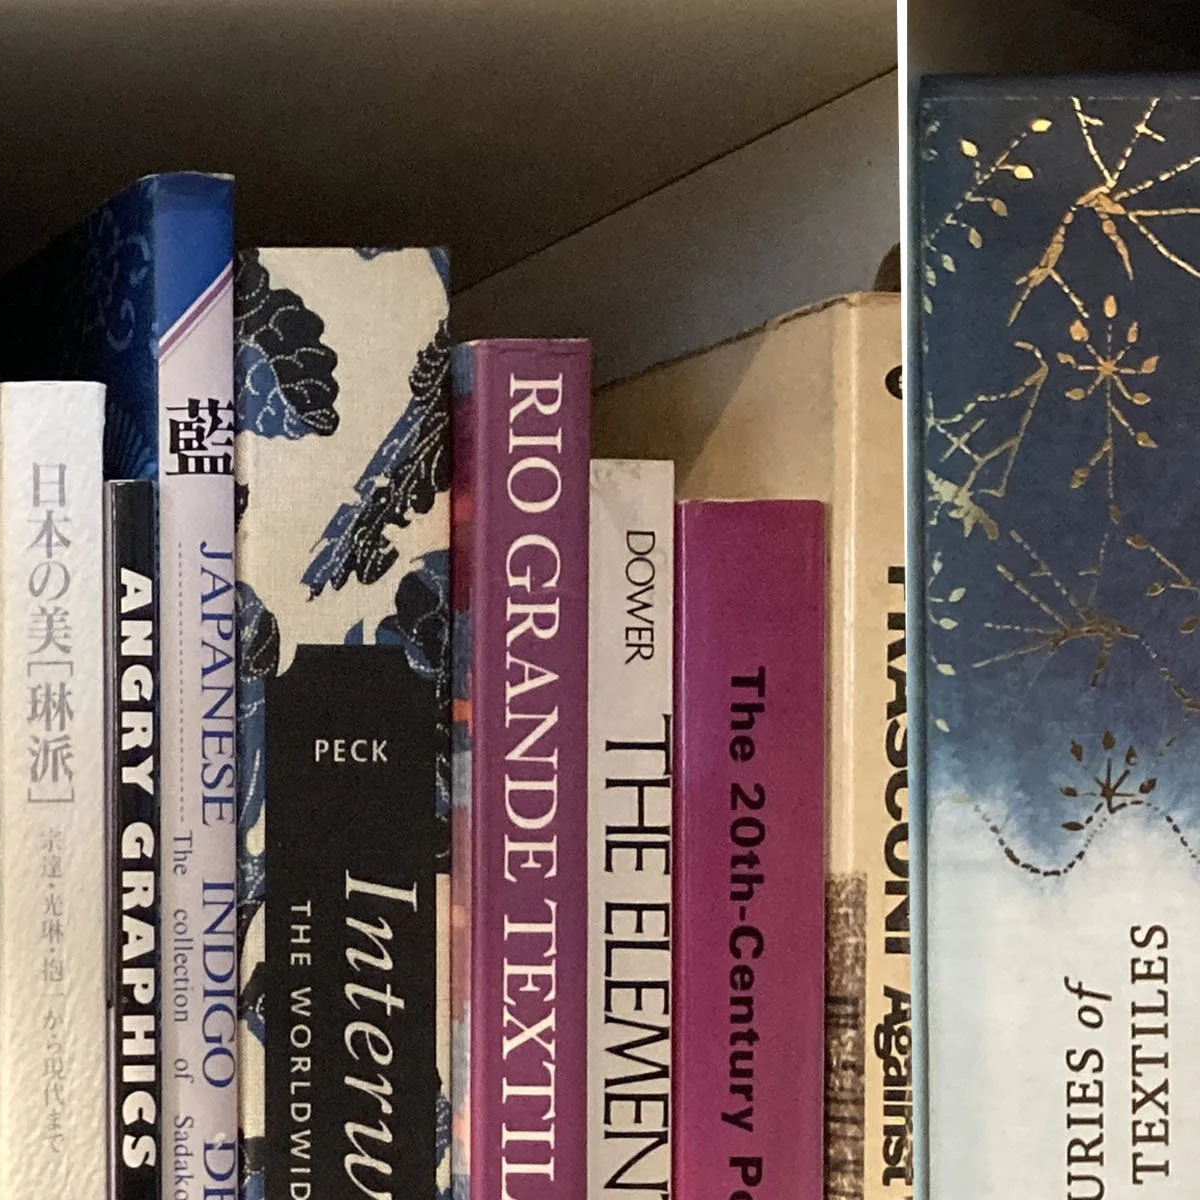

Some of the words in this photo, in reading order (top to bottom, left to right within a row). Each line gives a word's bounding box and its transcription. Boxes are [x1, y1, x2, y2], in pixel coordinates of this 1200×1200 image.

[165, 397, 236, 477] 藍
[506, 372, 563, 514] RIO
[624, 530, 656, 665] DOWER
[119, 567, 155, 793] ANGRY
[199, 540, 236, 826] JAPANESE
[503, 534, 561, 883] GRANDE
[729, 665, 766, 763] The
[315, 739, 388, 763] PECK
[604, 713, 673, 876] THE
[172, 830, 193, 876] The
[121, 821, 157, 1169] GRAPHICS
[172, 908, 195, 1023] collection
[201, 880, 237, 1088] INDIGO
[290, 900, 312, 966] THE
[721, 782, 766, 1133] 20th-Century
[173, 1057, 195, 1085] of
[1063, 975, 1112, 1030] of
[1129, 924, 1170, 1185] TEXTILES
